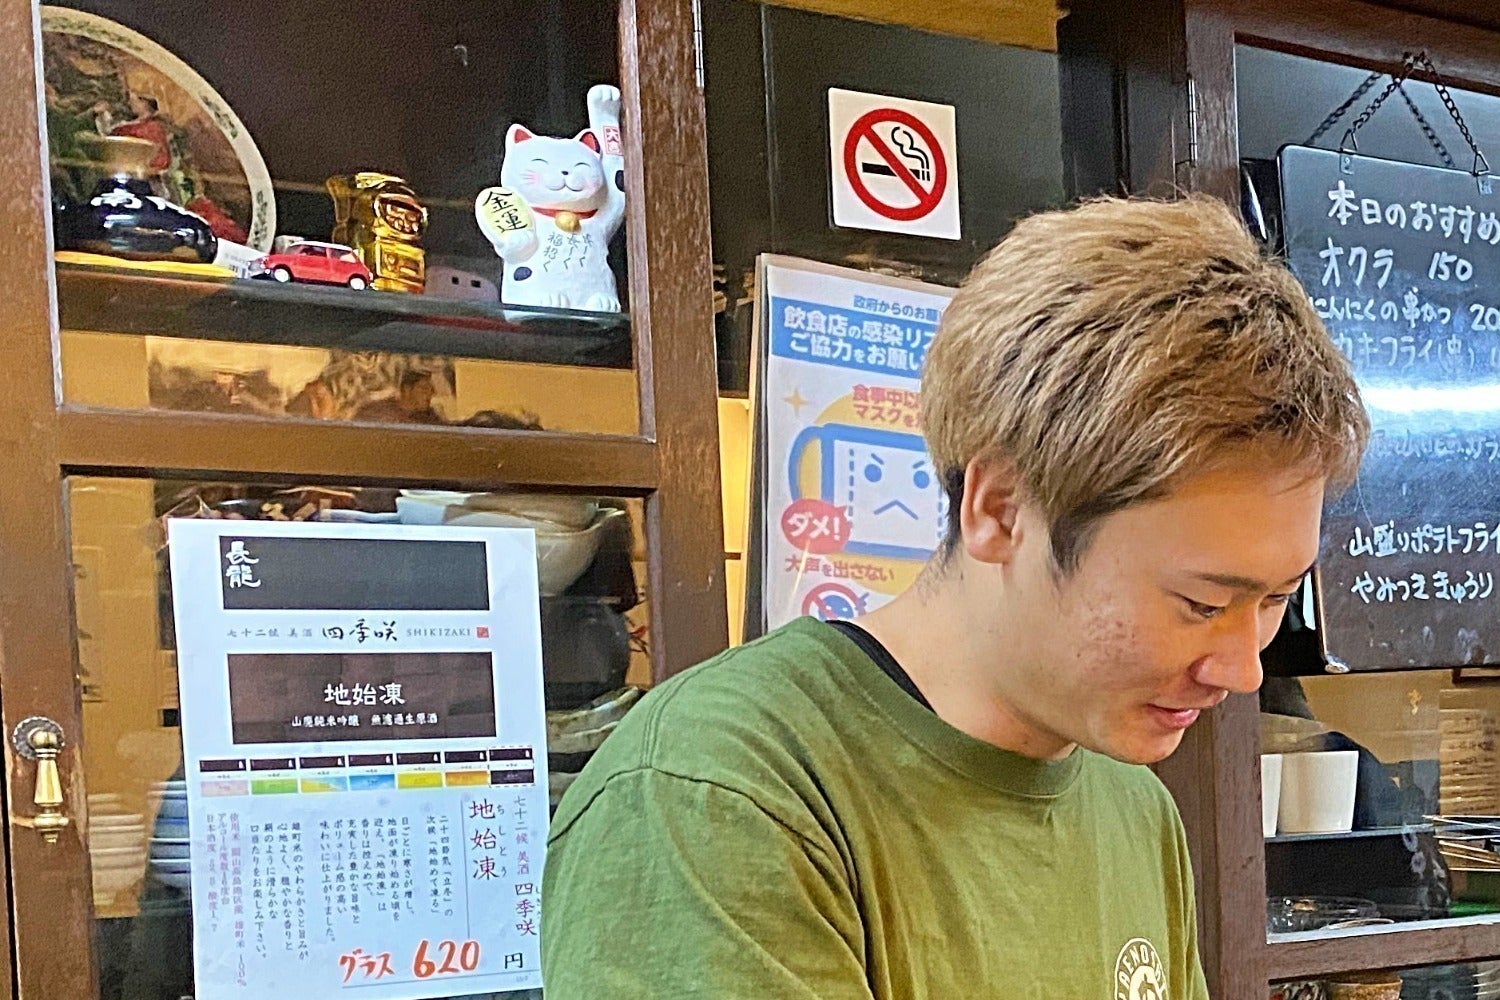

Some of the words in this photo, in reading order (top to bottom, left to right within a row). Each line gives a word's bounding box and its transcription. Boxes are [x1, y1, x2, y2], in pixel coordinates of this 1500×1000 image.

[482, 190, 528, 234] 金運
[1319, 237, 1394, 289] オクラ
[1428, 251, 1473, 282] 150
[853, 294, 941, 323] 政府からのお願
[784, 555, 895, 583] 大声を出さない
[322, 618, 398, 643] 四季咲
[406, 627, 471, 638] SHIKIZAKI
[323, 682, 406, 706] 地始凍
[469, 798, 500, 881] 地始凍
[515, 882, 537, 937] 四季咲
[338, 947, 396, 984] グラス
[413, 938, 481, 982] 620
[503, 952, 524, 970] 円
